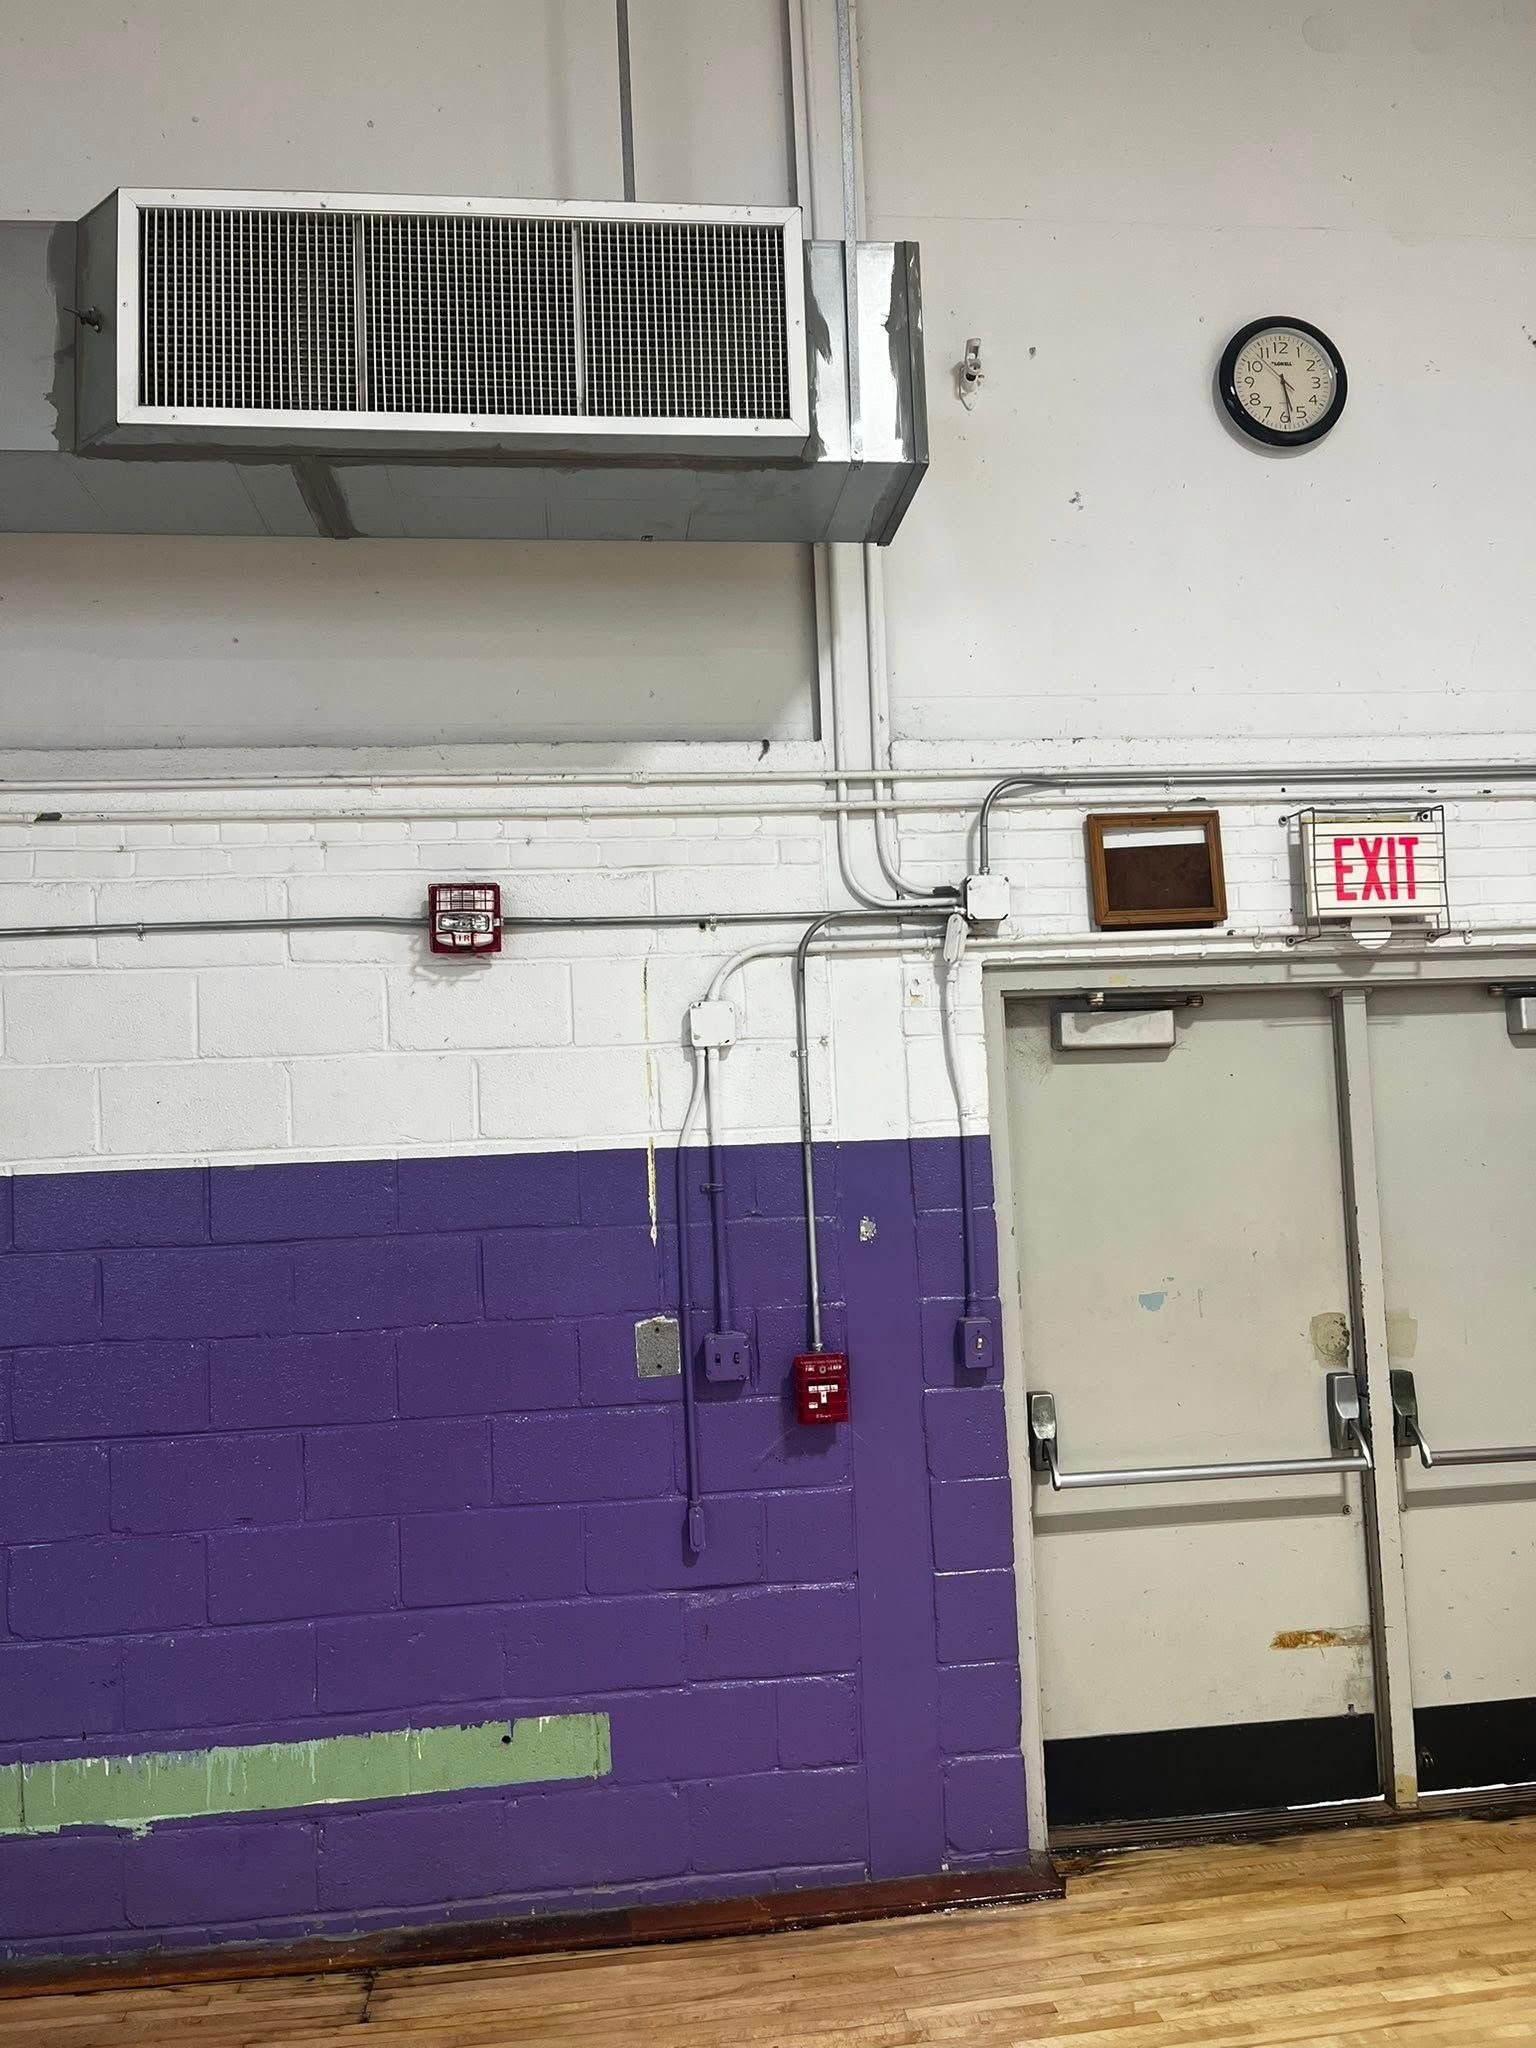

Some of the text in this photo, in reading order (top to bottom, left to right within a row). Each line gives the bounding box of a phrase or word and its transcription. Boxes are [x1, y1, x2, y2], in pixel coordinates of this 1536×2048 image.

[1260, 347, 1270, 359] 11
[1273, 342, 1288, 354] 12
[1296, 346, 1301, 358] 1
[1247, 360, 1263, 373] 10
[1306, 360, 1316, 372] 2
[1244, 376, 1255, 389] 9
[1311, 377, 1321, 389] 3
[1249, 392, 1261, 406] 8
[1308, 395, 1318, 405] 4
[1263, 406, 1272, 418] 7
[1280, 411, 1291, 424] 6
[1296, 406, 1307, 419] 5
[1333, 837, 1419, 901] EXIT
